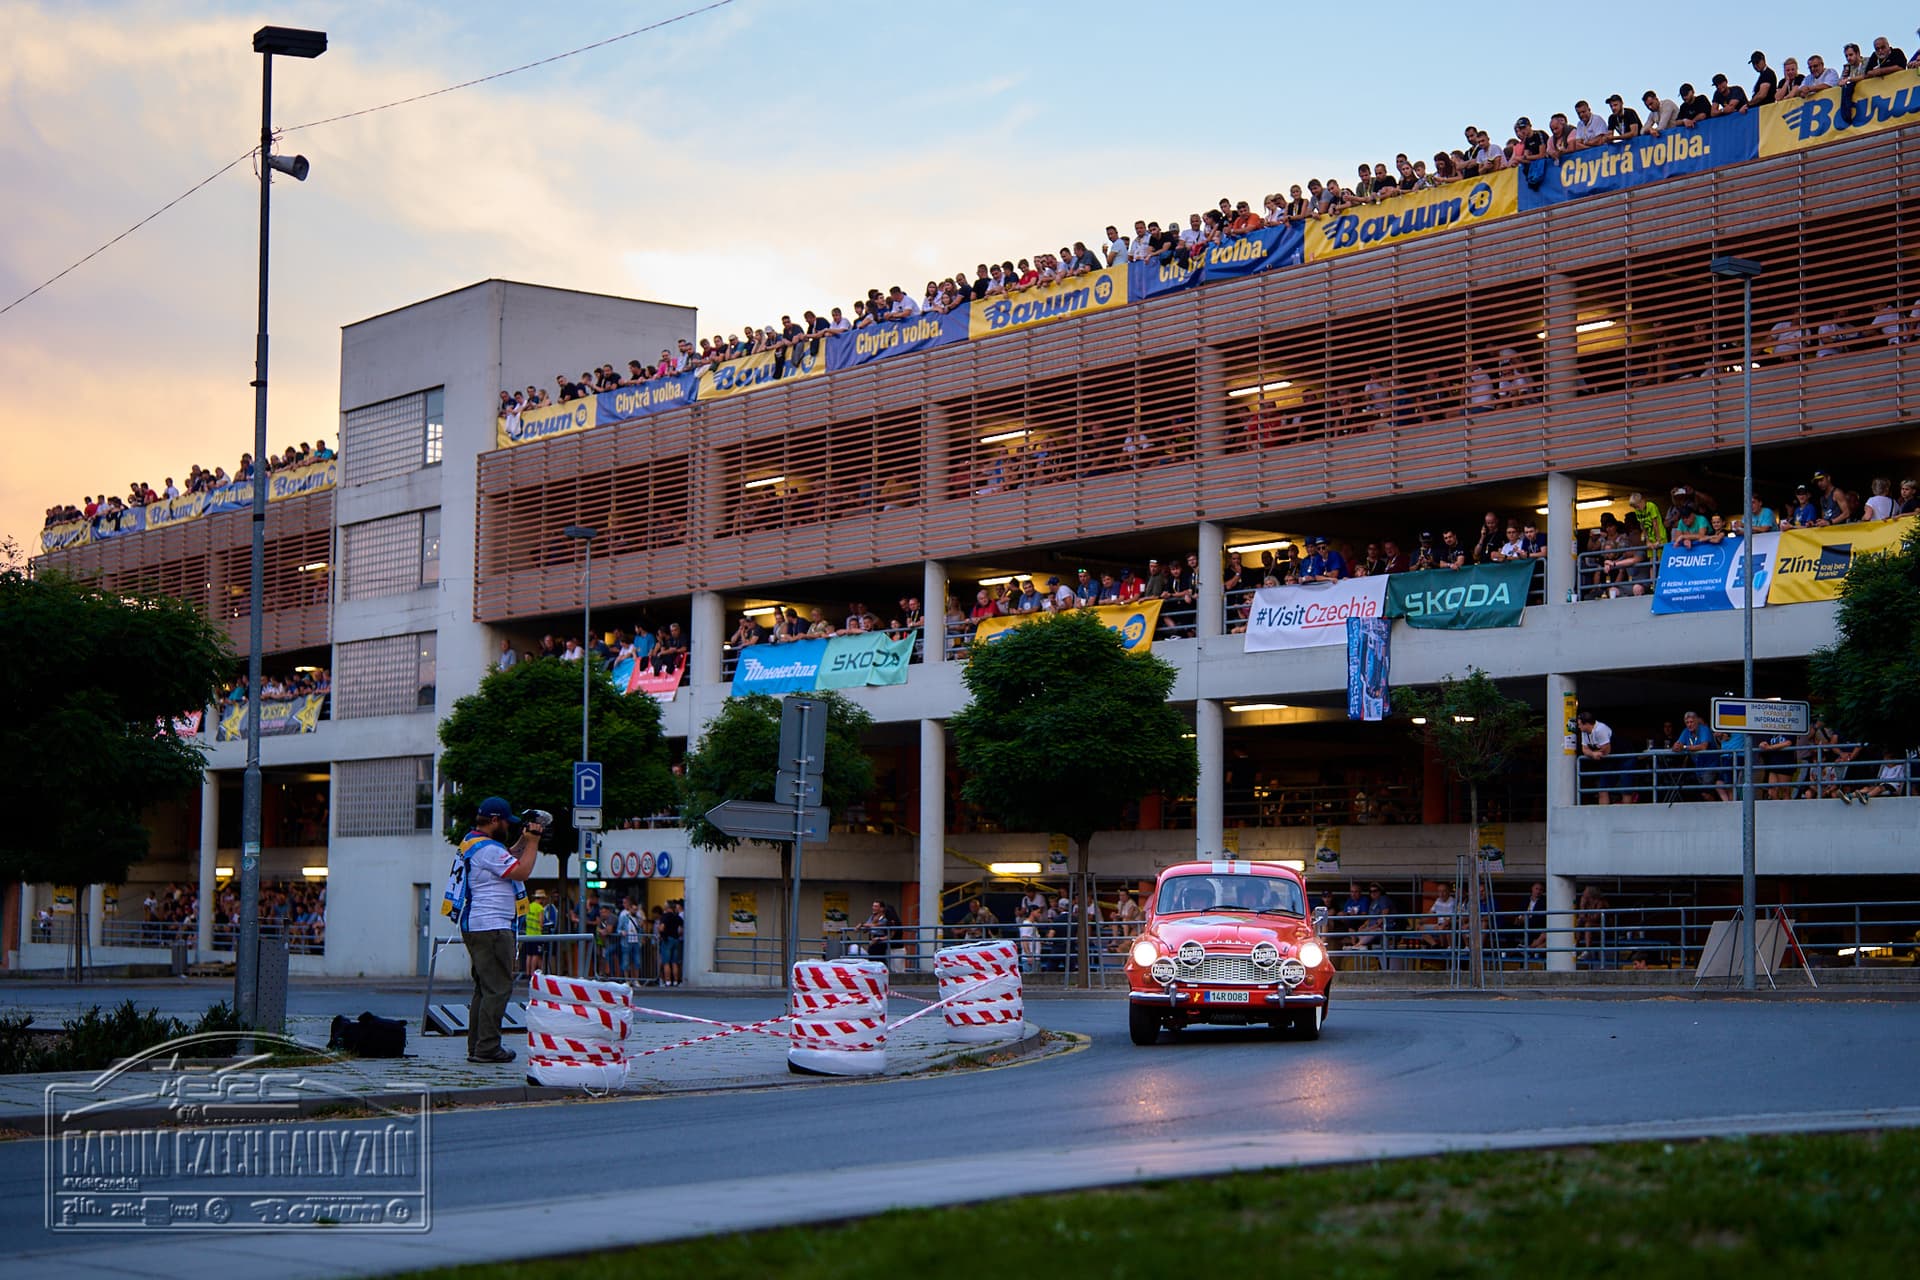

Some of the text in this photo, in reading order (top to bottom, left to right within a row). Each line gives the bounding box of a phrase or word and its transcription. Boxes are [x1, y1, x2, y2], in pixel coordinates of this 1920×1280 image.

[1782, 85, 1920, 141] Baru
[1560, 133, 1711, 187] Chytrá volba.
[1322, 197, 1463, 249] Barum
[1210, 238, 1268, 264] volba.
[984, 287, 1090, 330] Barum
[855, 319, 943, 356] Chytrá volba.
[615, 381, 685, 414] Chytrá volba.
[1667, 553, 1715, 568] PSWNET
[1256, 596, 1377, 627] #VisitCzechia
[743, 658, 817, 681] Mototechna
[580, 775, 596, 800] P
[1211, 992, 1248, 1001] 14R 0083
